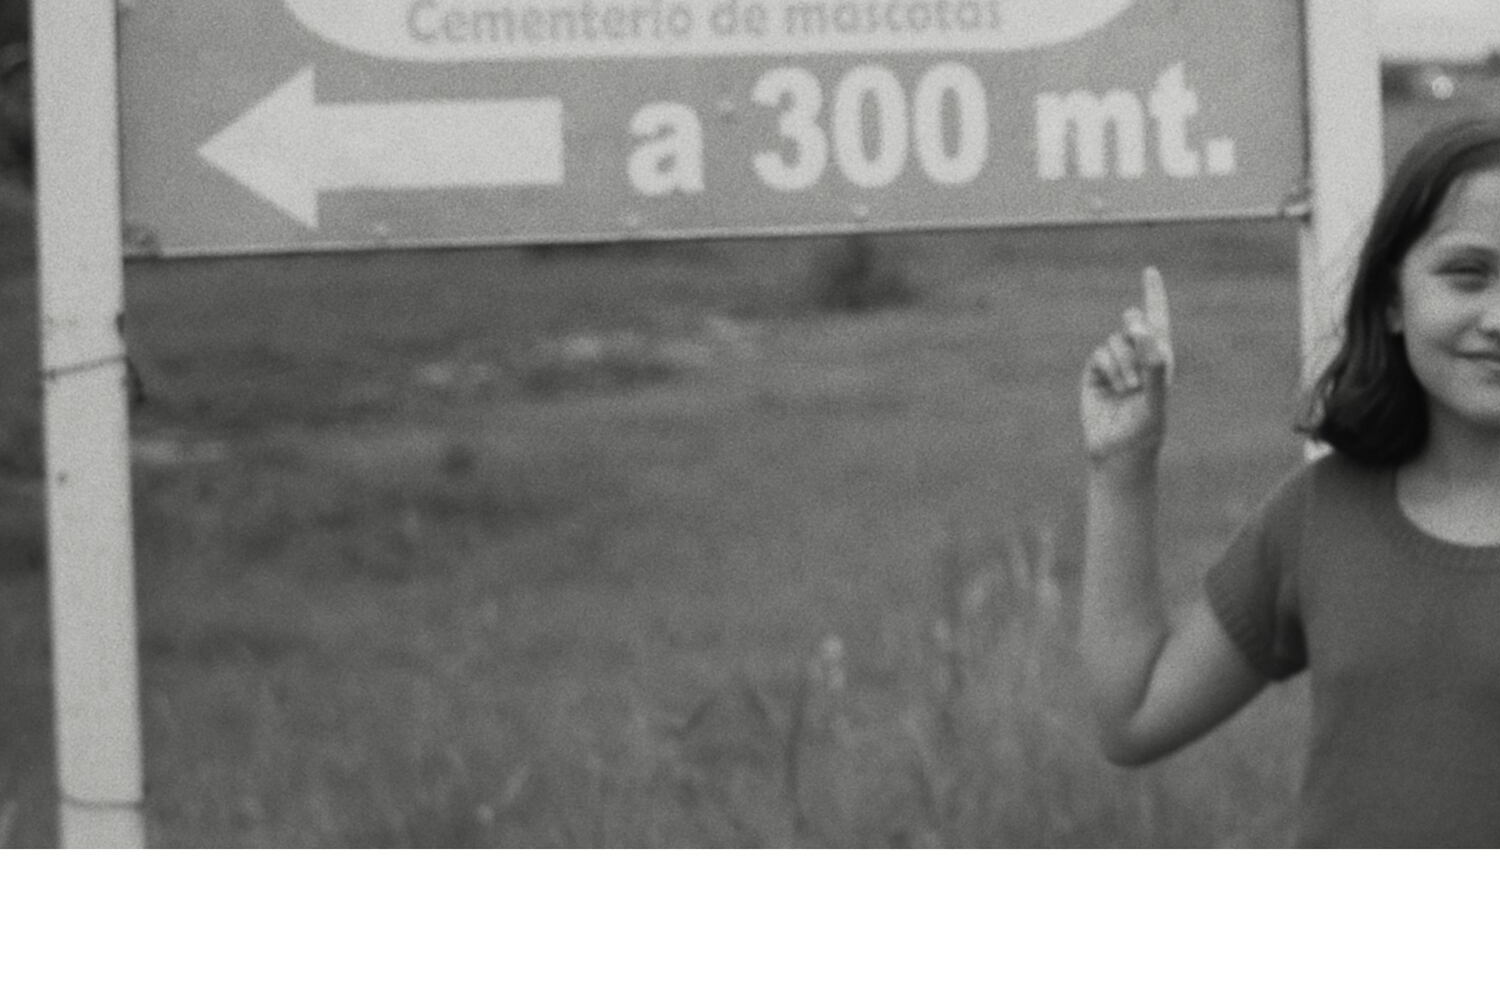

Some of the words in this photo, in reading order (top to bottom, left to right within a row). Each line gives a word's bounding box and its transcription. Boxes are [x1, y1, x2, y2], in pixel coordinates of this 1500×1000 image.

[627, 101, 705, 195] a
[751, 61, 989, 191] 300
[1034, 60, 1236, 181] mt.
